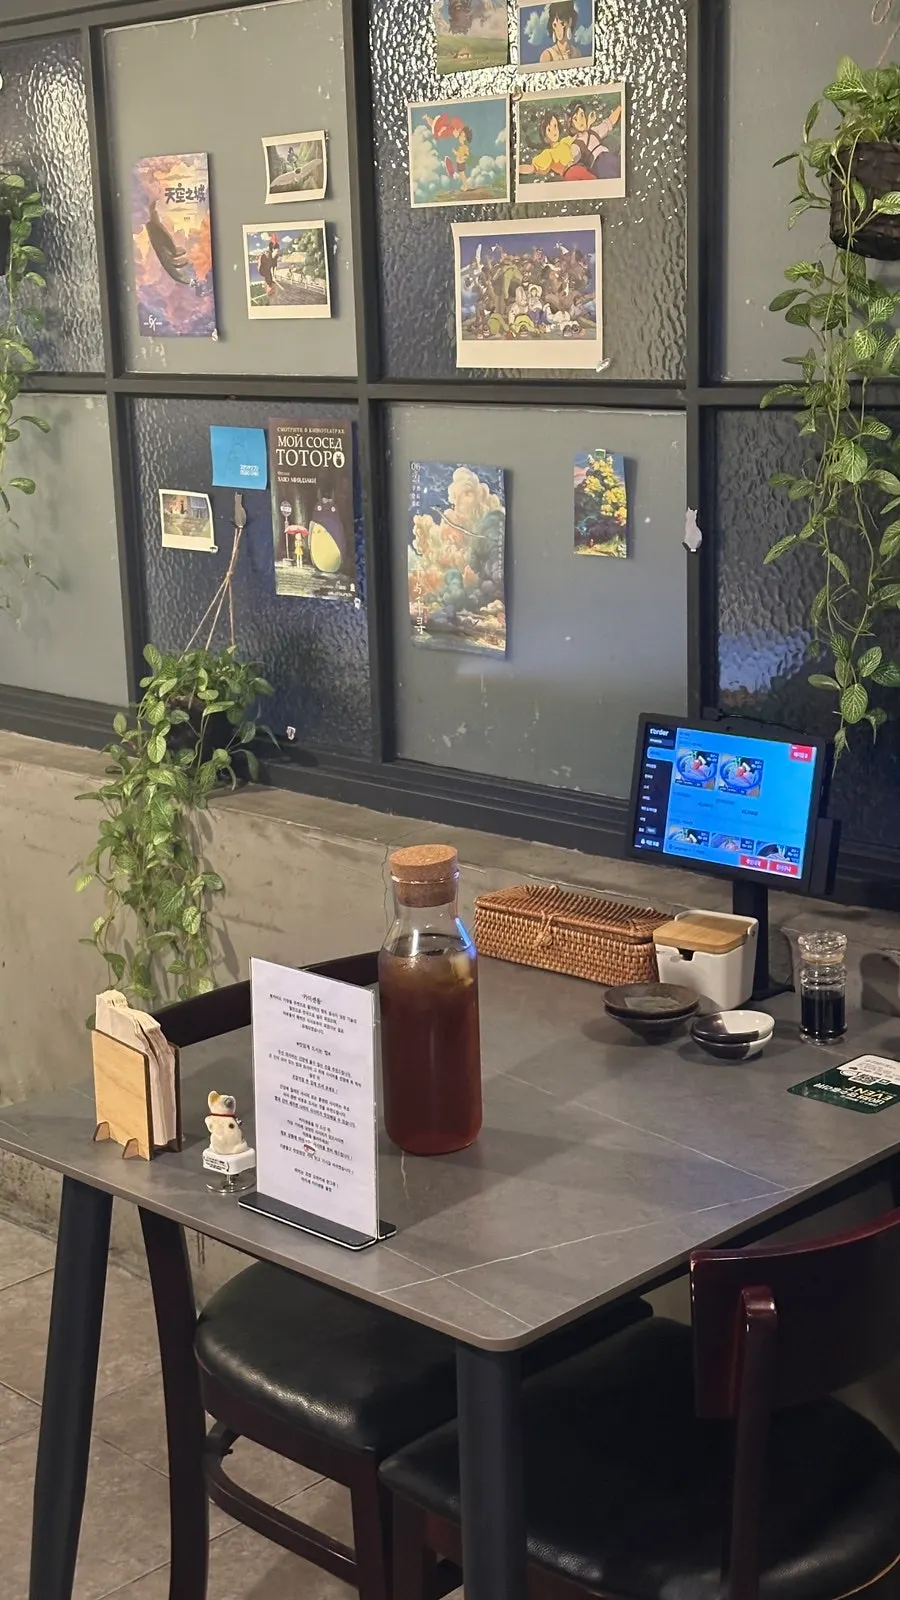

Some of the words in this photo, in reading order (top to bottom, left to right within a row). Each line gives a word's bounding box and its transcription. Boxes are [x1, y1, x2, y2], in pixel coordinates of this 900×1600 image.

[277, 434, 303, 448] МОЙ
[306, 436, 343, 451] СОСЕД
[275, 448, 345, 468] ТОТОРО
[844, 1086, 894, 1100] EVENT
